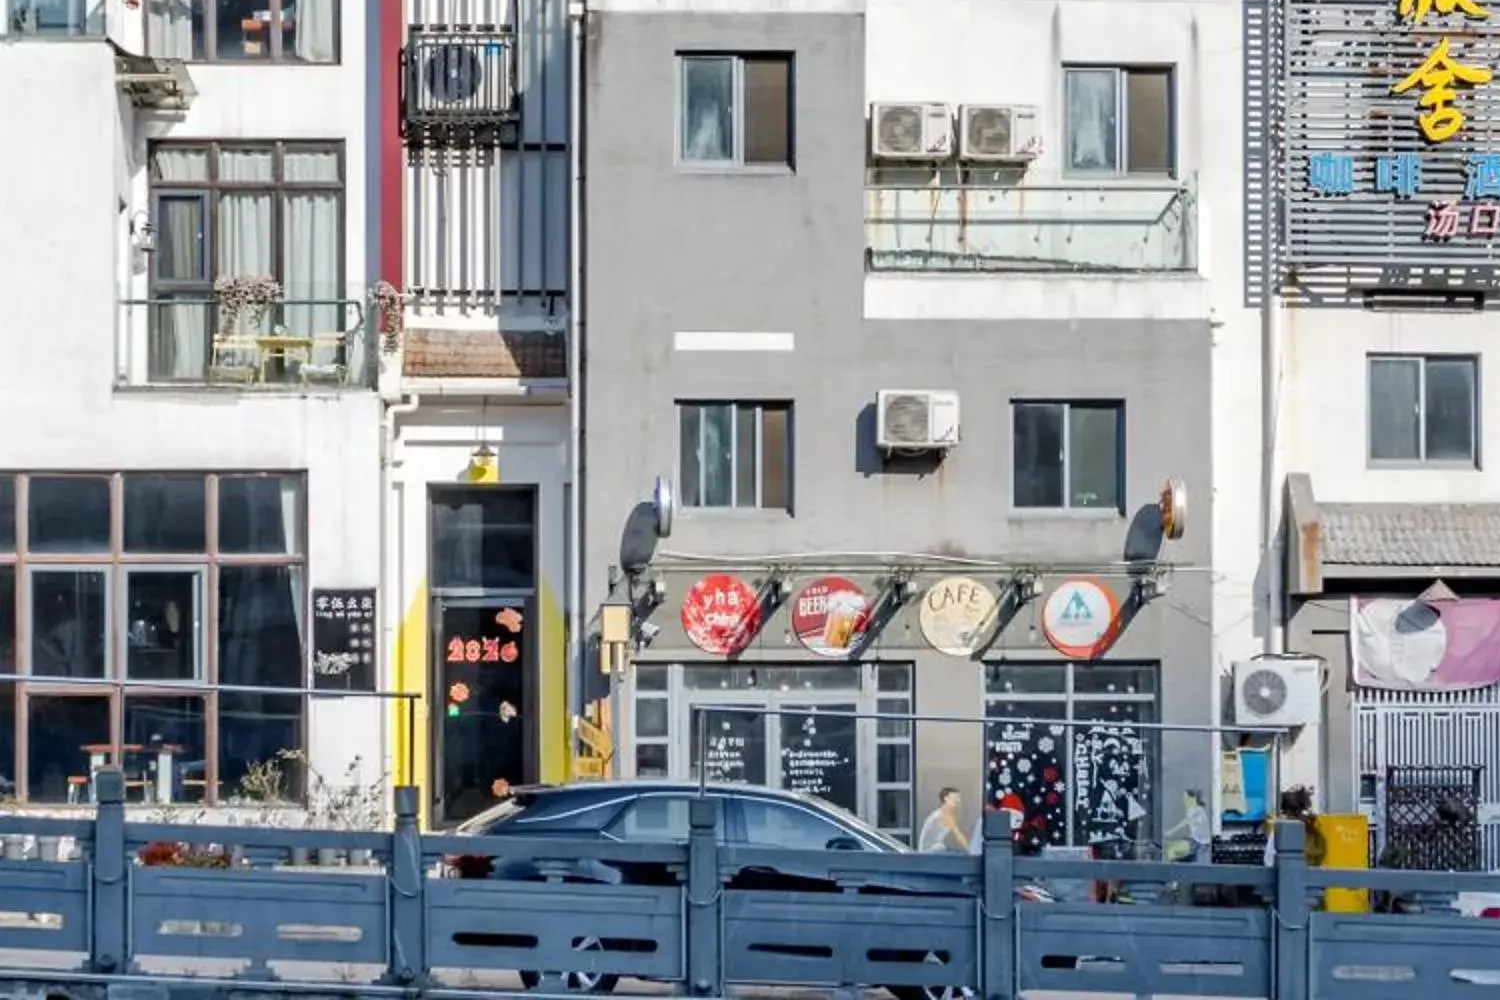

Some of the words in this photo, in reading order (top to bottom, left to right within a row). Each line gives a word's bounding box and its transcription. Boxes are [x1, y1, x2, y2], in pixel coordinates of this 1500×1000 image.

[1308, 151, 1422, 199] 咖啡
[703, 589, 740, 611] yha
[928, 582, 980, 613] CAFE
